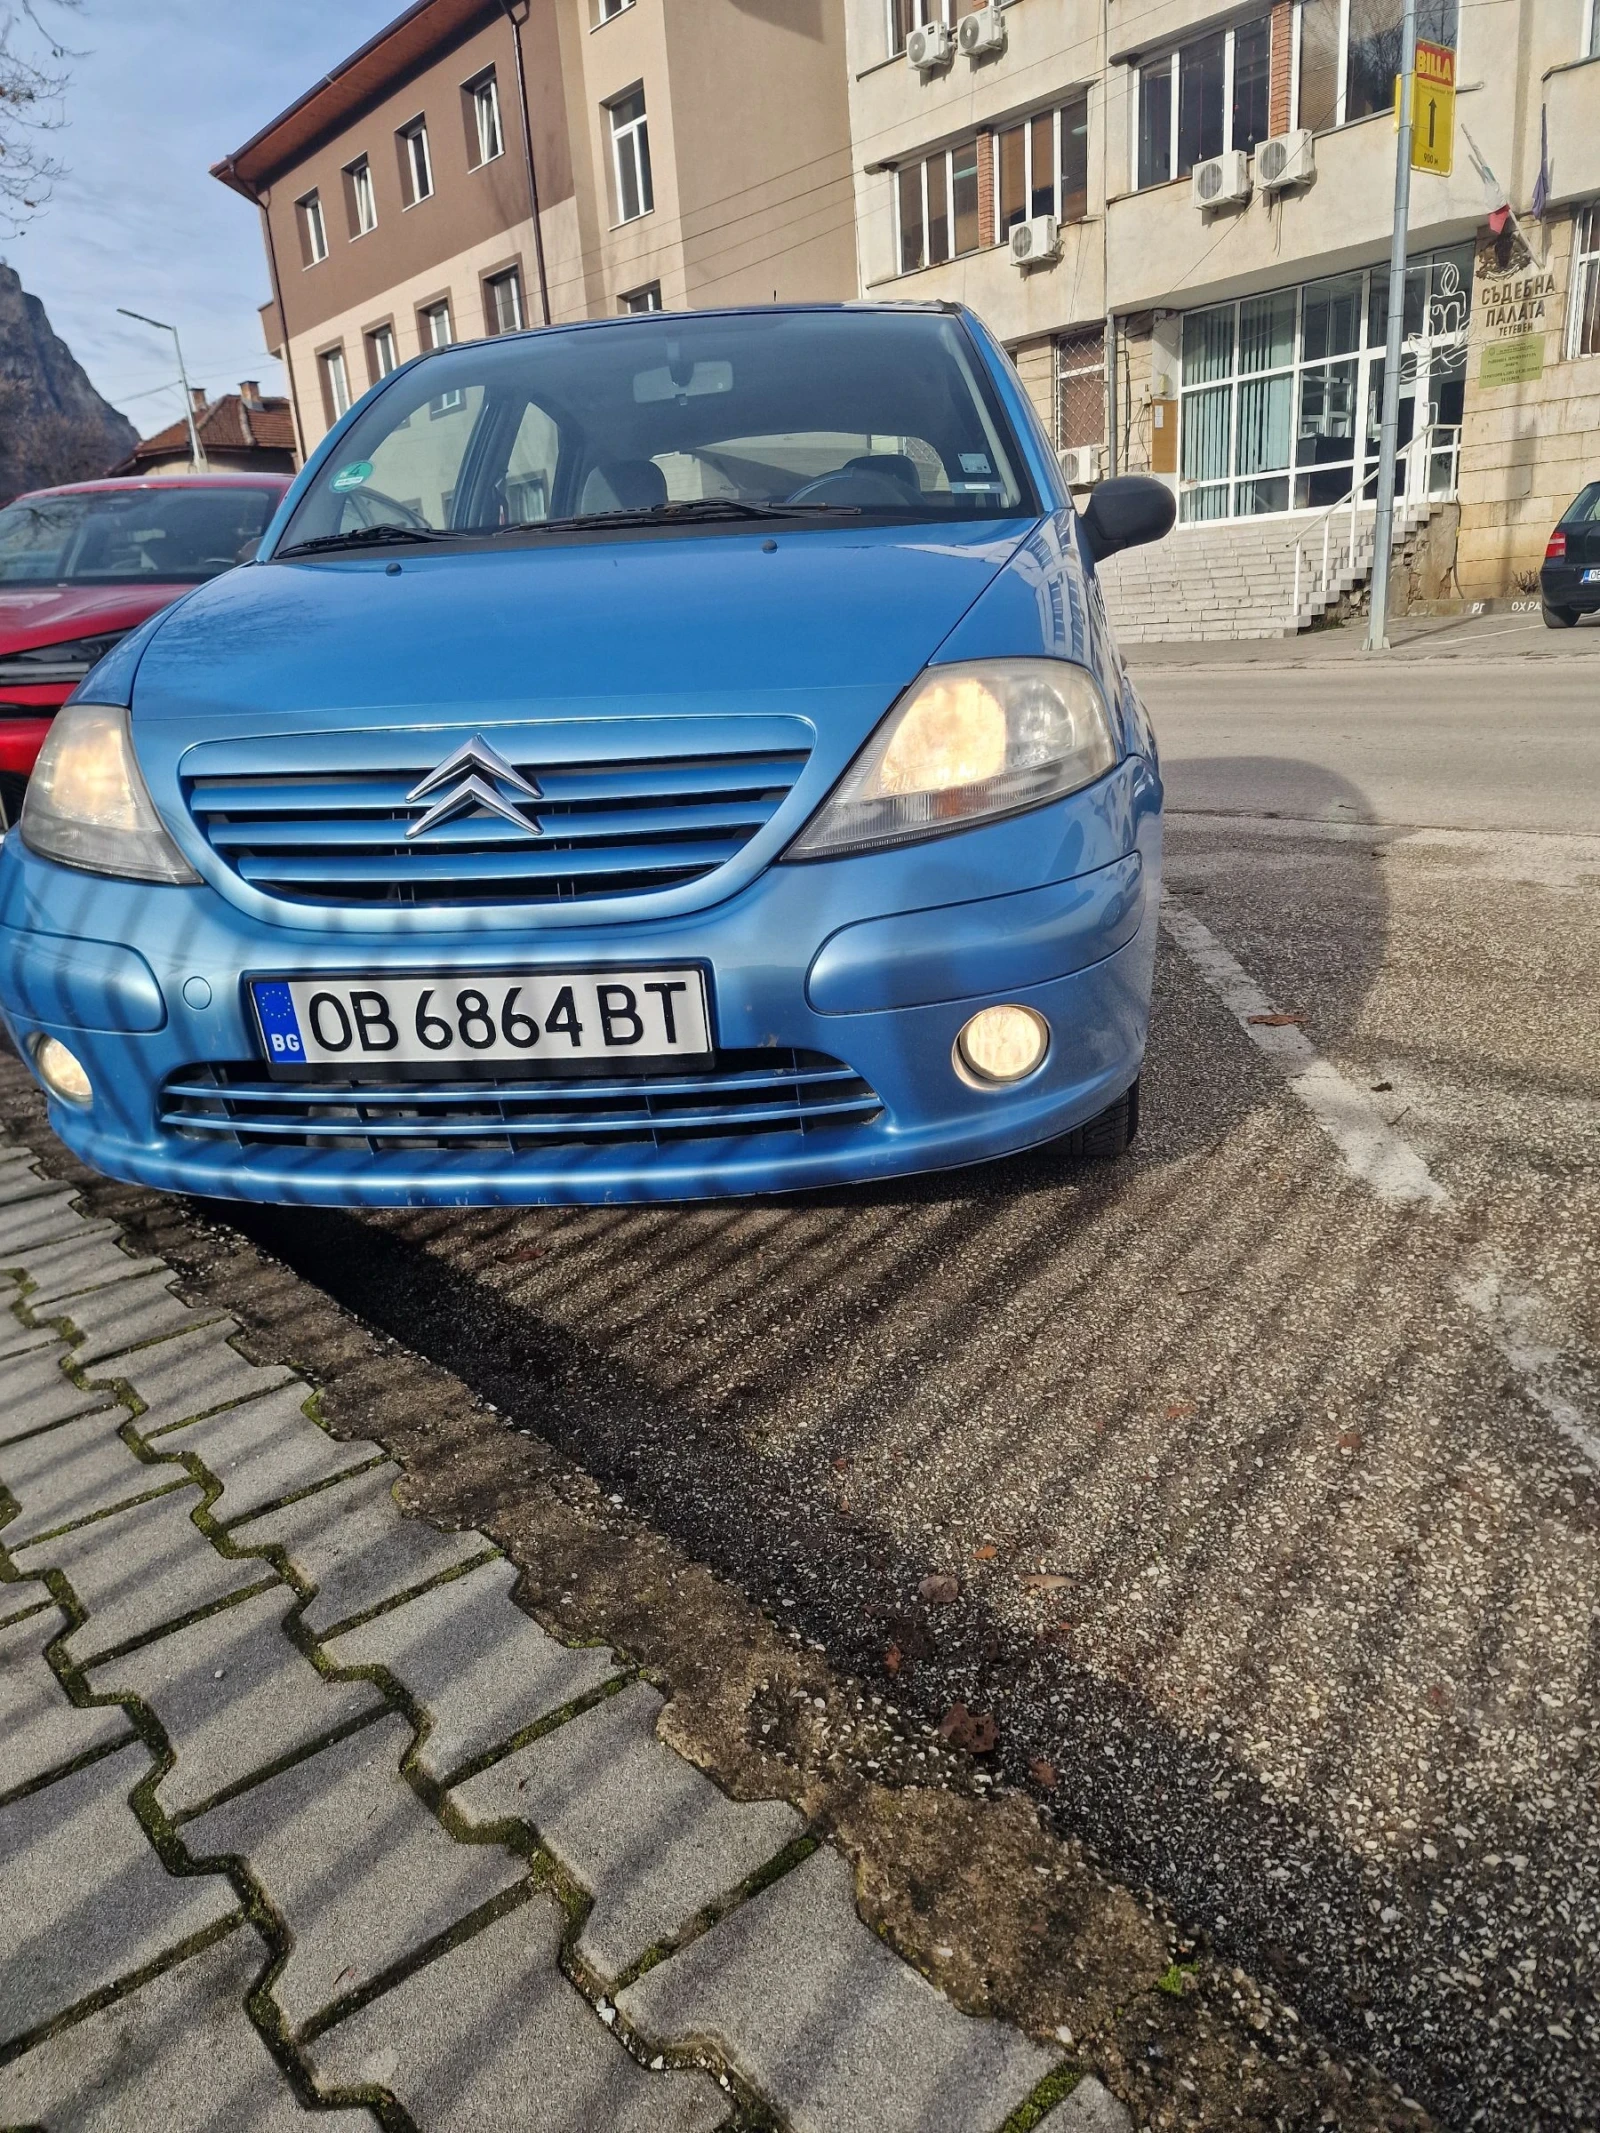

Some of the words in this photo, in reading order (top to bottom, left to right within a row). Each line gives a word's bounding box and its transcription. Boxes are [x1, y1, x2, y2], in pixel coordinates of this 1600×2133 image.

[1416, 50, 1452, 81] BILLA
[1423, 152, 1434, 164] 900
[1482, 274, 1555, 305] СЪДЕБНА
[1486, 300, 1545, 327] ПАЛАТА
[1499, 322, 1533, 337] ТЕТЕВЕН
[415, 985, 583, 1051] 6864
[270, 1033, 300, 1052] BG
